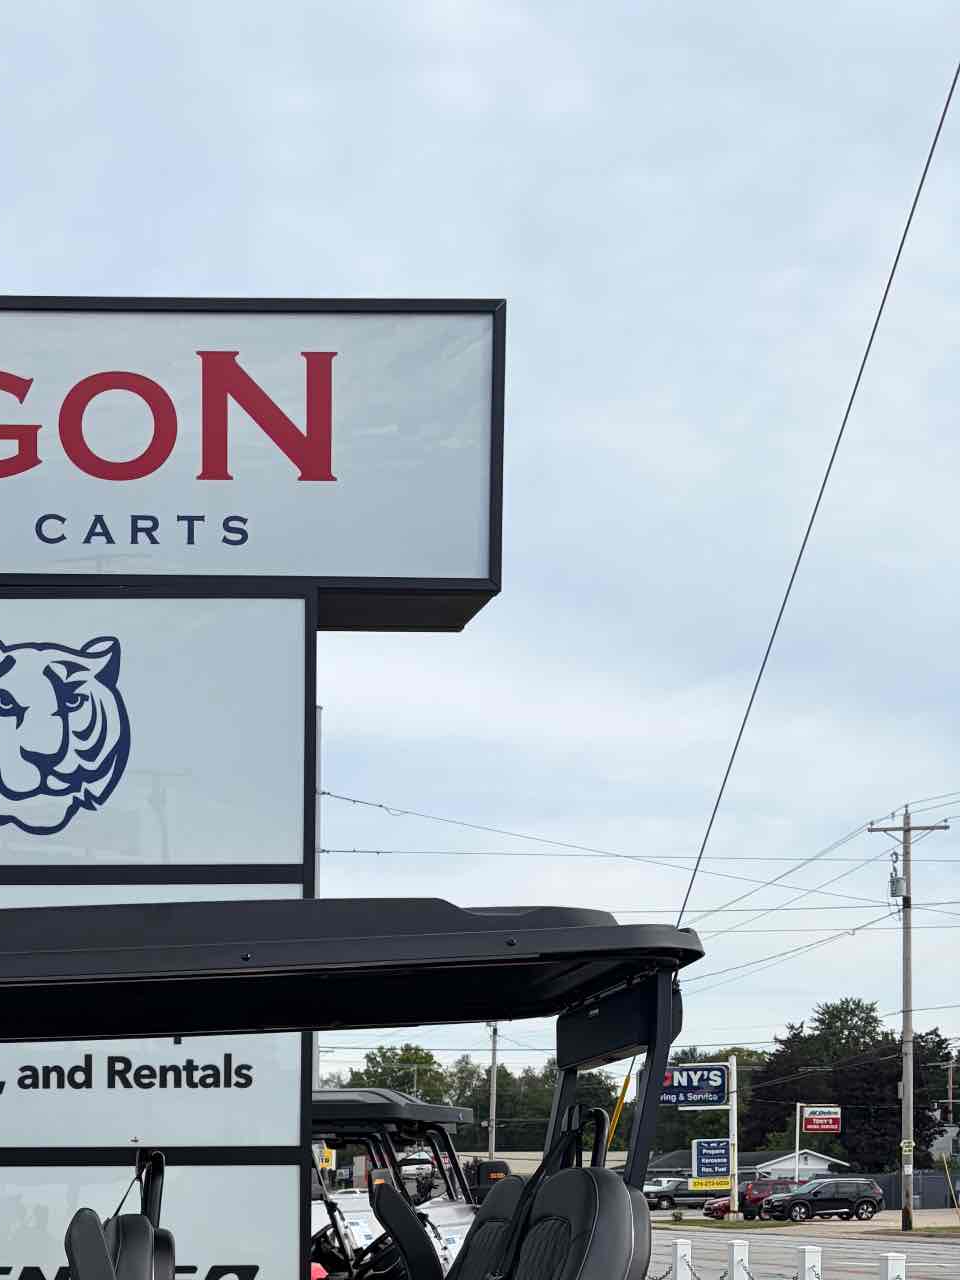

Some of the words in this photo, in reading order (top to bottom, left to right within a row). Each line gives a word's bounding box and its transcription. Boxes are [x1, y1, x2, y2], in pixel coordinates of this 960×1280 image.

[34, 512, 250, 547] CARTS
[17, 1053, 93, 1090] and
[107, 1052, 253, 1090] Rentals
[687, 1092, 718, 1101] Service
